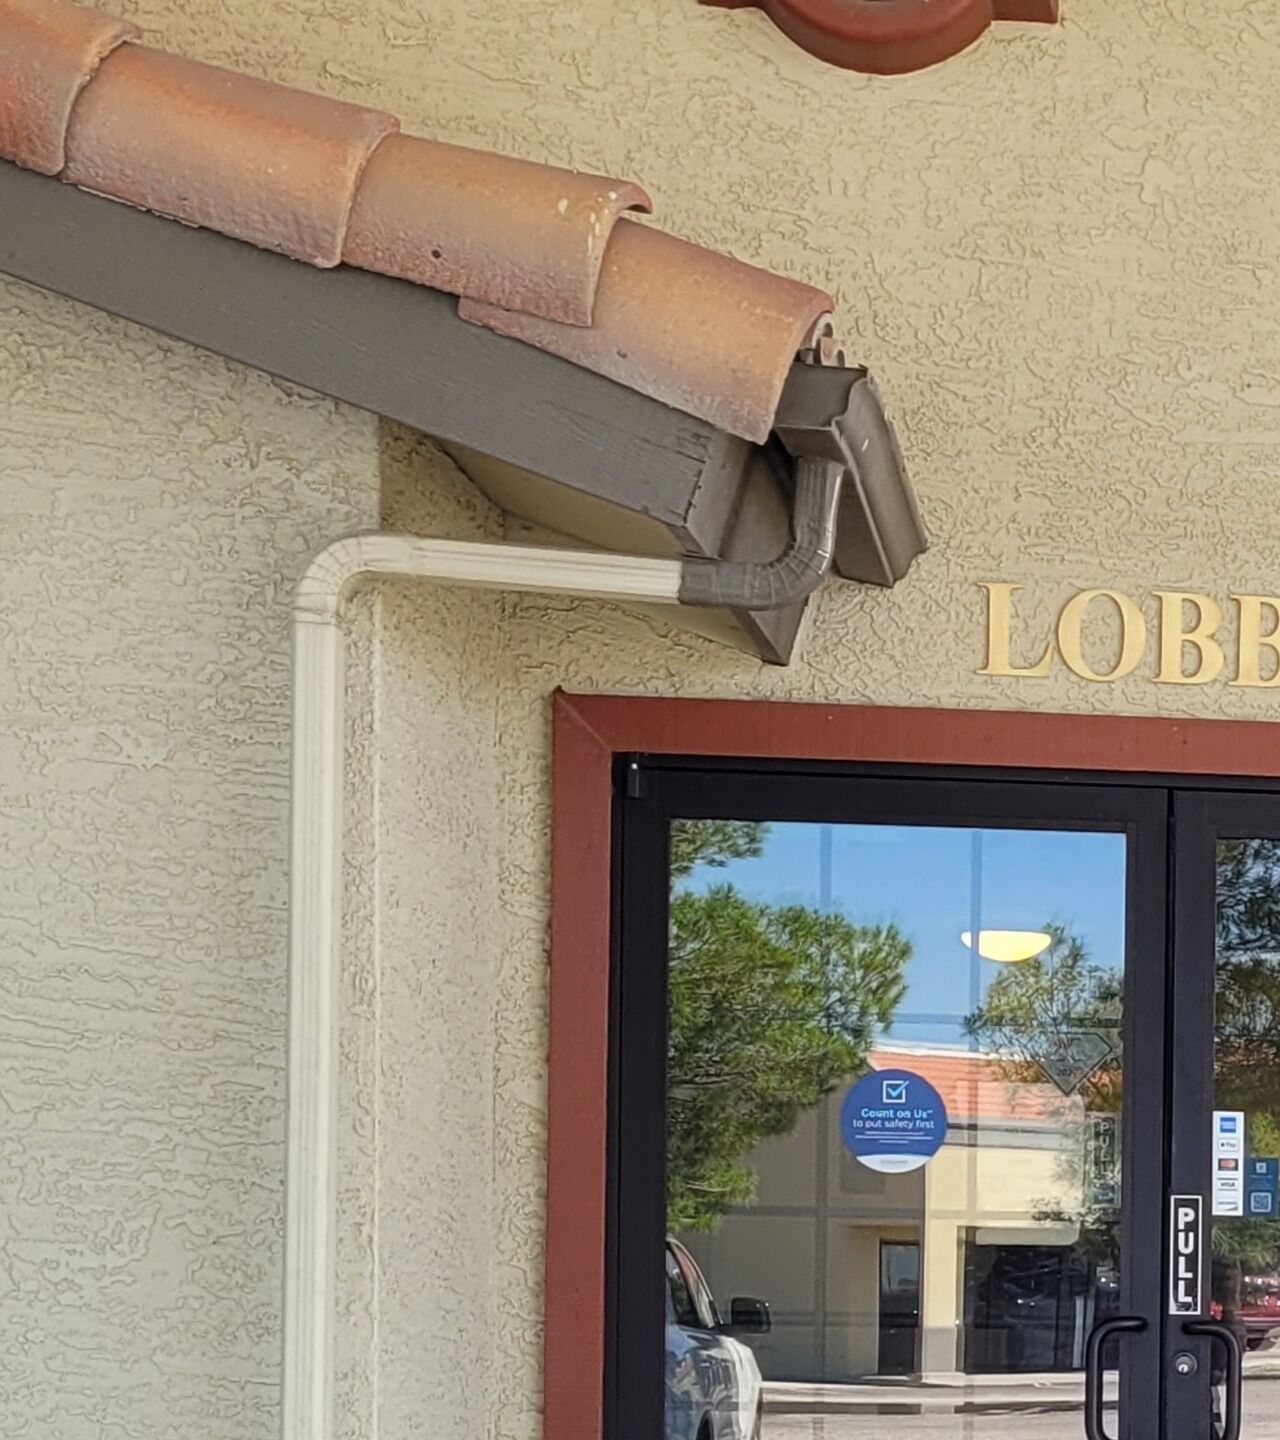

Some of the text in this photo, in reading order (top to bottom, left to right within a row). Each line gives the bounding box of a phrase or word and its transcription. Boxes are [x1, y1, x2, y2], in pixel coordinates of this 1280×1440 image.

[861, 1108, 895, 1119] Count
[897, 1110, 912, 1119] on
[853, 1119, 935, 1130] to put safety first
[1178, 1207, 1196, 1303] PULL
